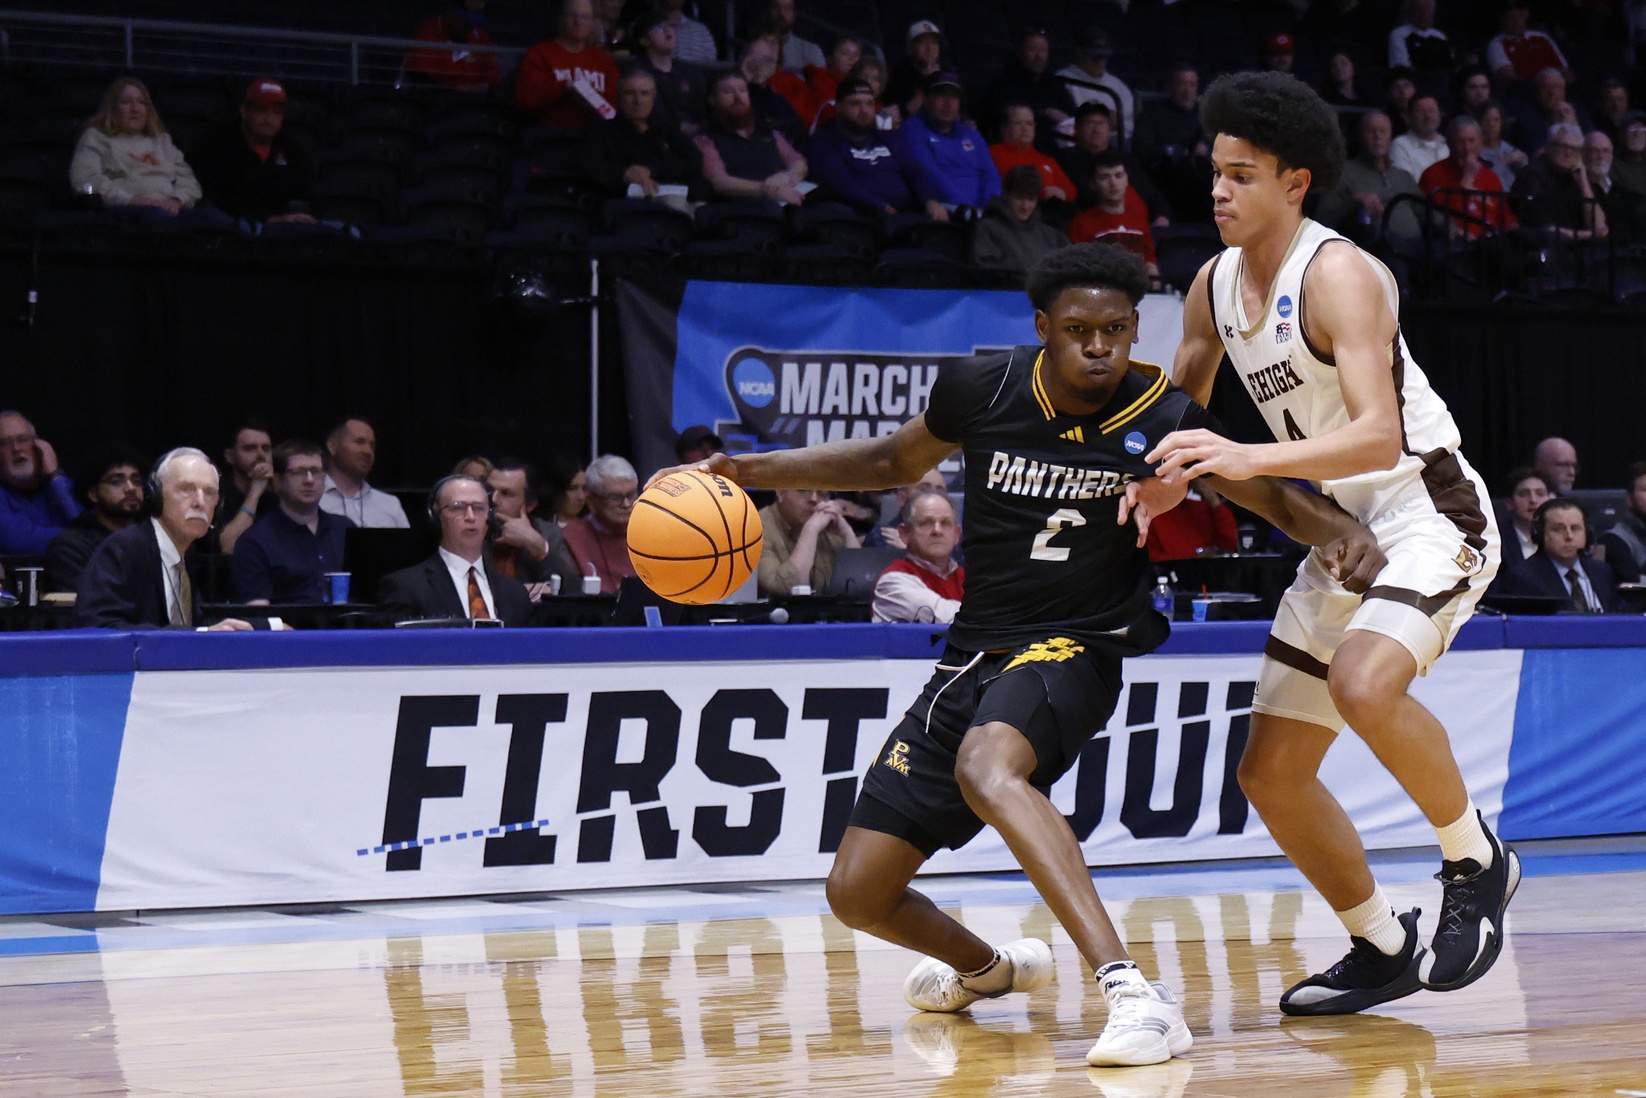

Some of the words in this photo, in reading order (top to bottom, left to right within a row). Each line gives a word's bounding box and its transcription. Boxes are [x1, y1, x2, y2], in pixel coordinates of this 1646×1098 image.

[739, 381, 776, 396] NCAA
[780, 362, 939, 415] MARCH
[1247, 359, 1305, 404] EHIGH
[1029, 508, 1087, 562] 2
[381, 688, 890, 872] FIRST
